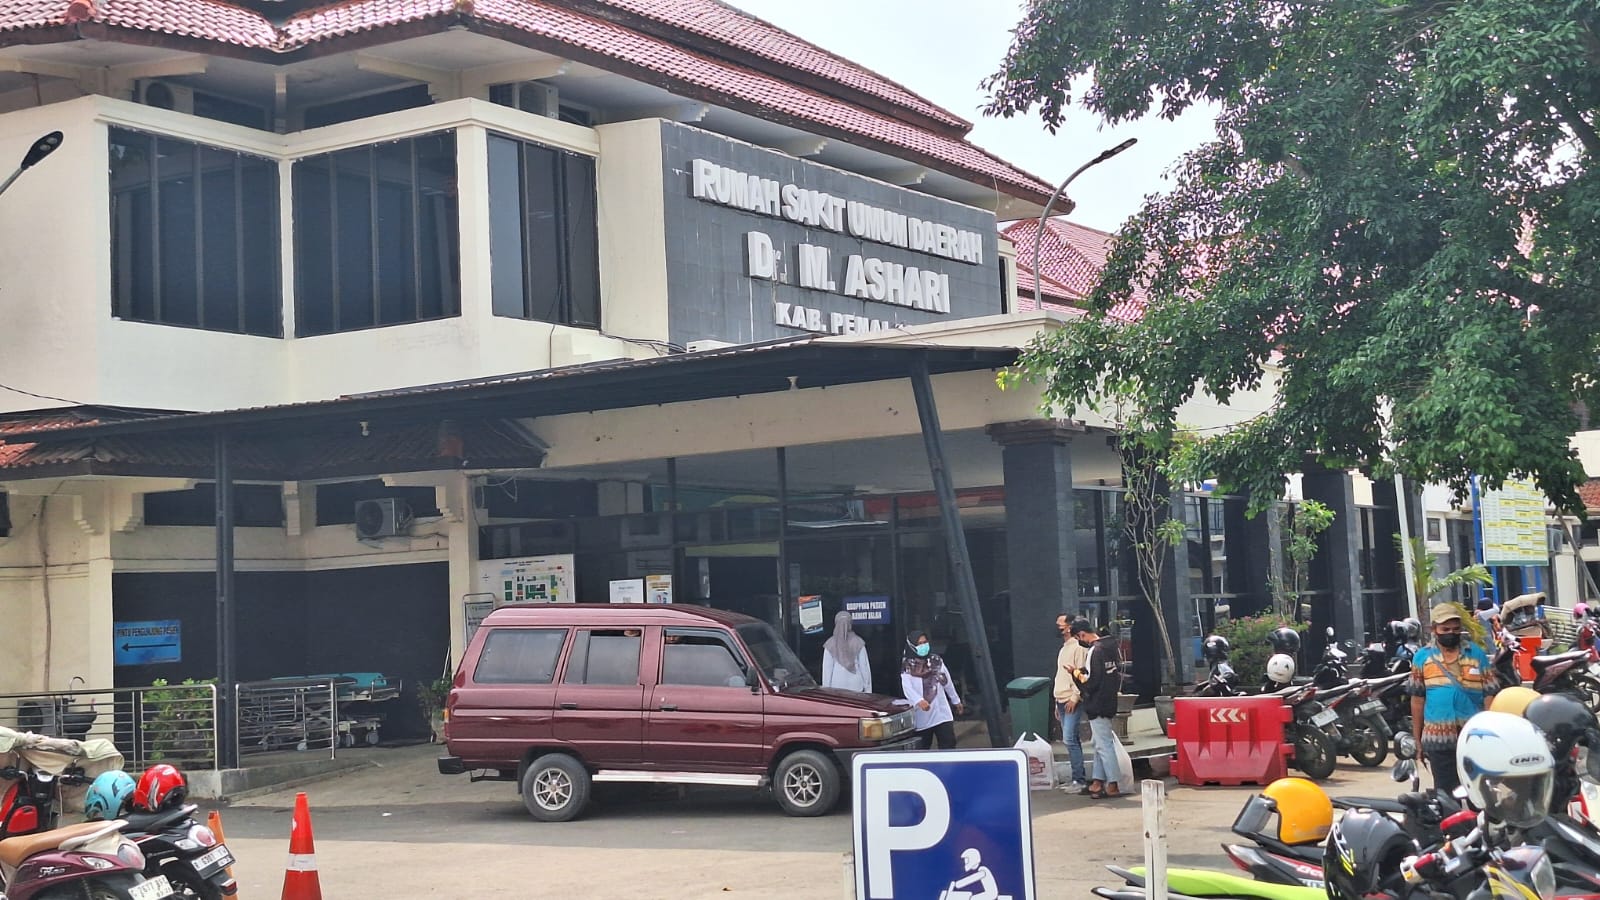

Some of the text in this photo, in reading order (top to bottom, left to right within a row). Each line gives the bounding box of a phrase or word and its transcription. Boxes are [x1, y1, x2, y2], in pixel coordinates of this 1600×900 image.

[692, 158, 983, 265] RUMAH SAKIT UMUM DAERAH
[799, 243, 836, 291] M.
[844, 254, 951, 314] ASHARI
[775, 301, 827, 332] KAB.
[1514, 756, 1541, 764] INK
[865, 767, 951, 899] P
